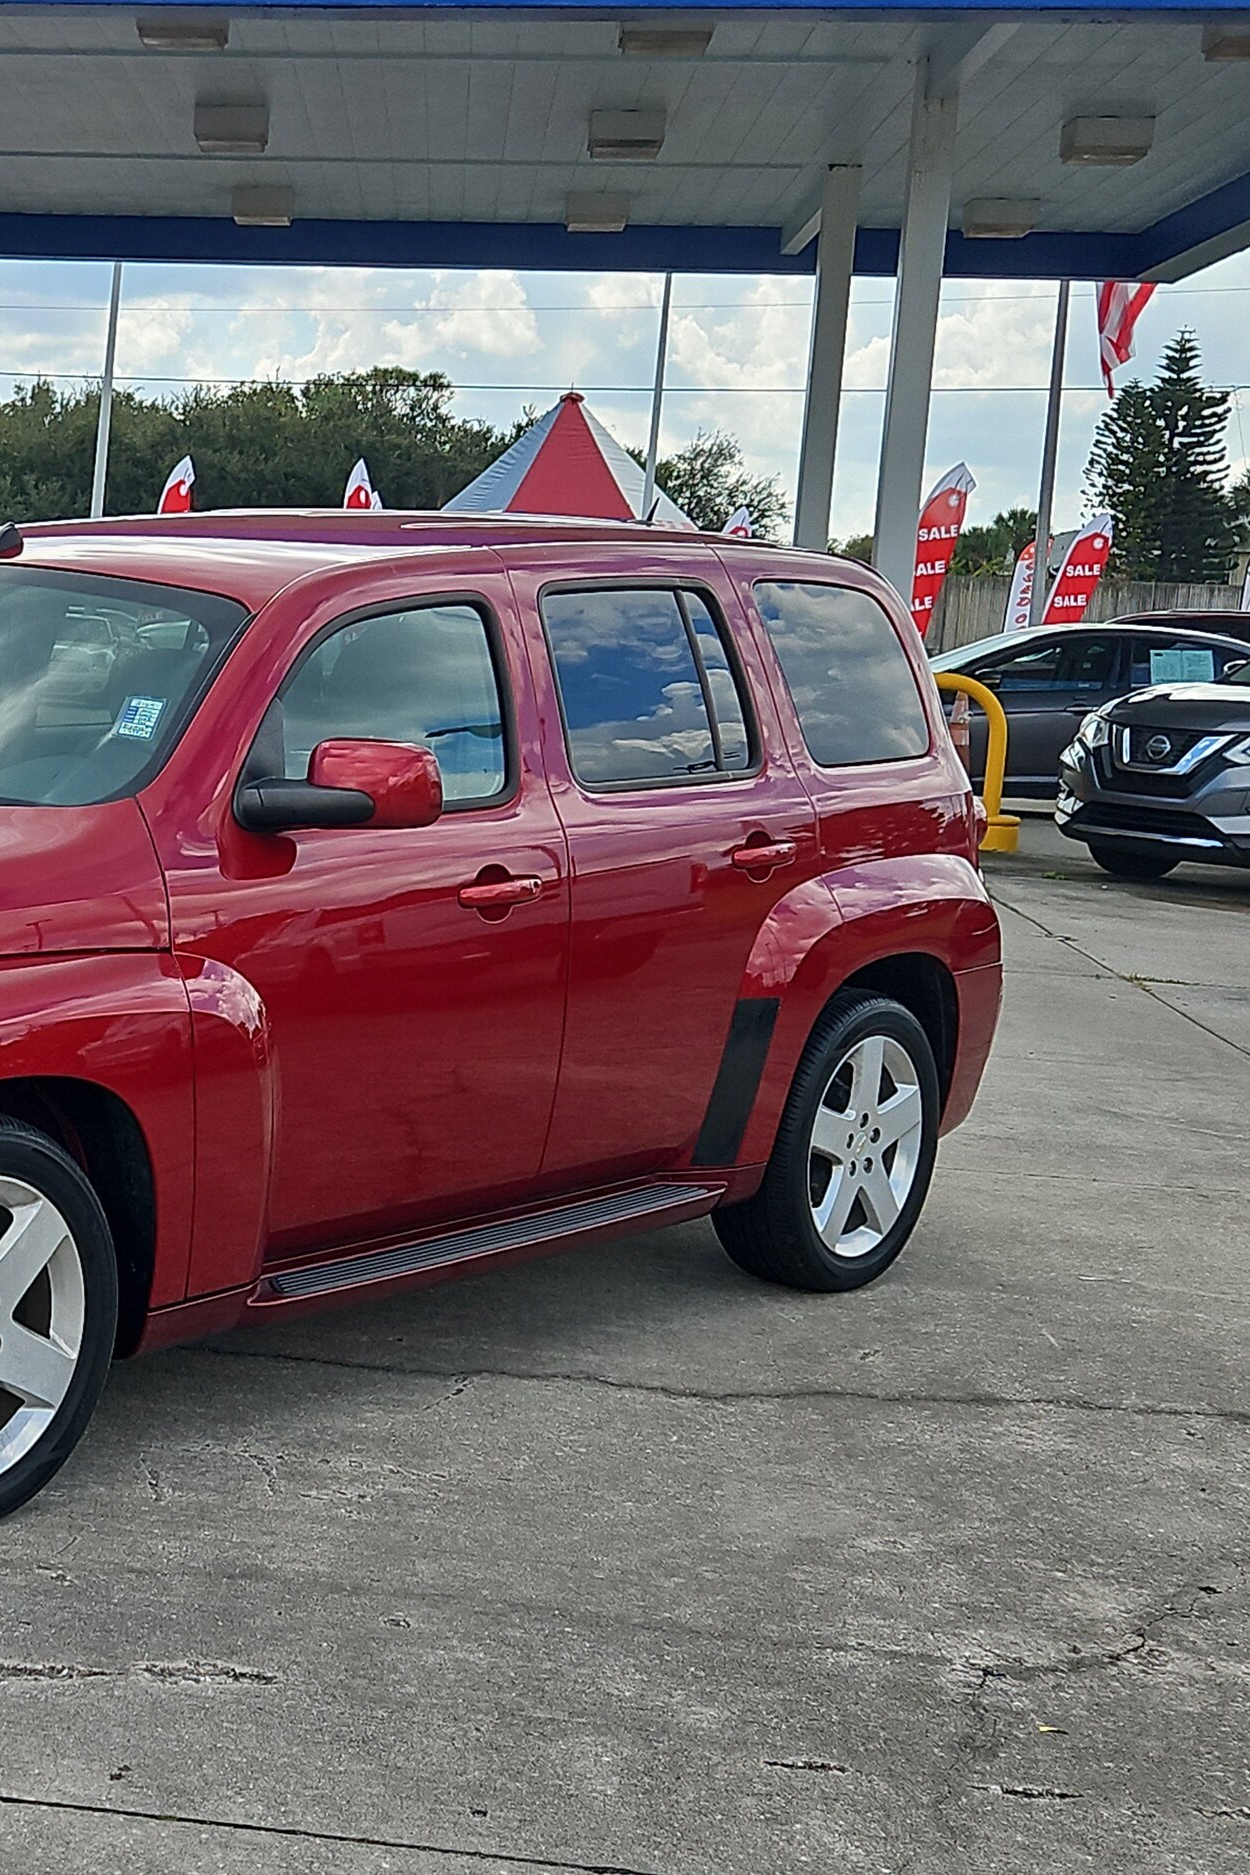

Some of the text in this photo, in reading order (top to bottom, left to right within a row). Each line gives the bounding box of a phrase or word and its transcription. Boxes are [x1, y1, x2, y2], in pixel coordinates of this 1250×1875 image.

[918, 525, 959, 541] SALE
[915, 560, 946, 576] ALE
[1065, 564, 1101, 577] SALE
[911, 596, 933, 612] LE
[1053, 594, 1087, 608] SALE
